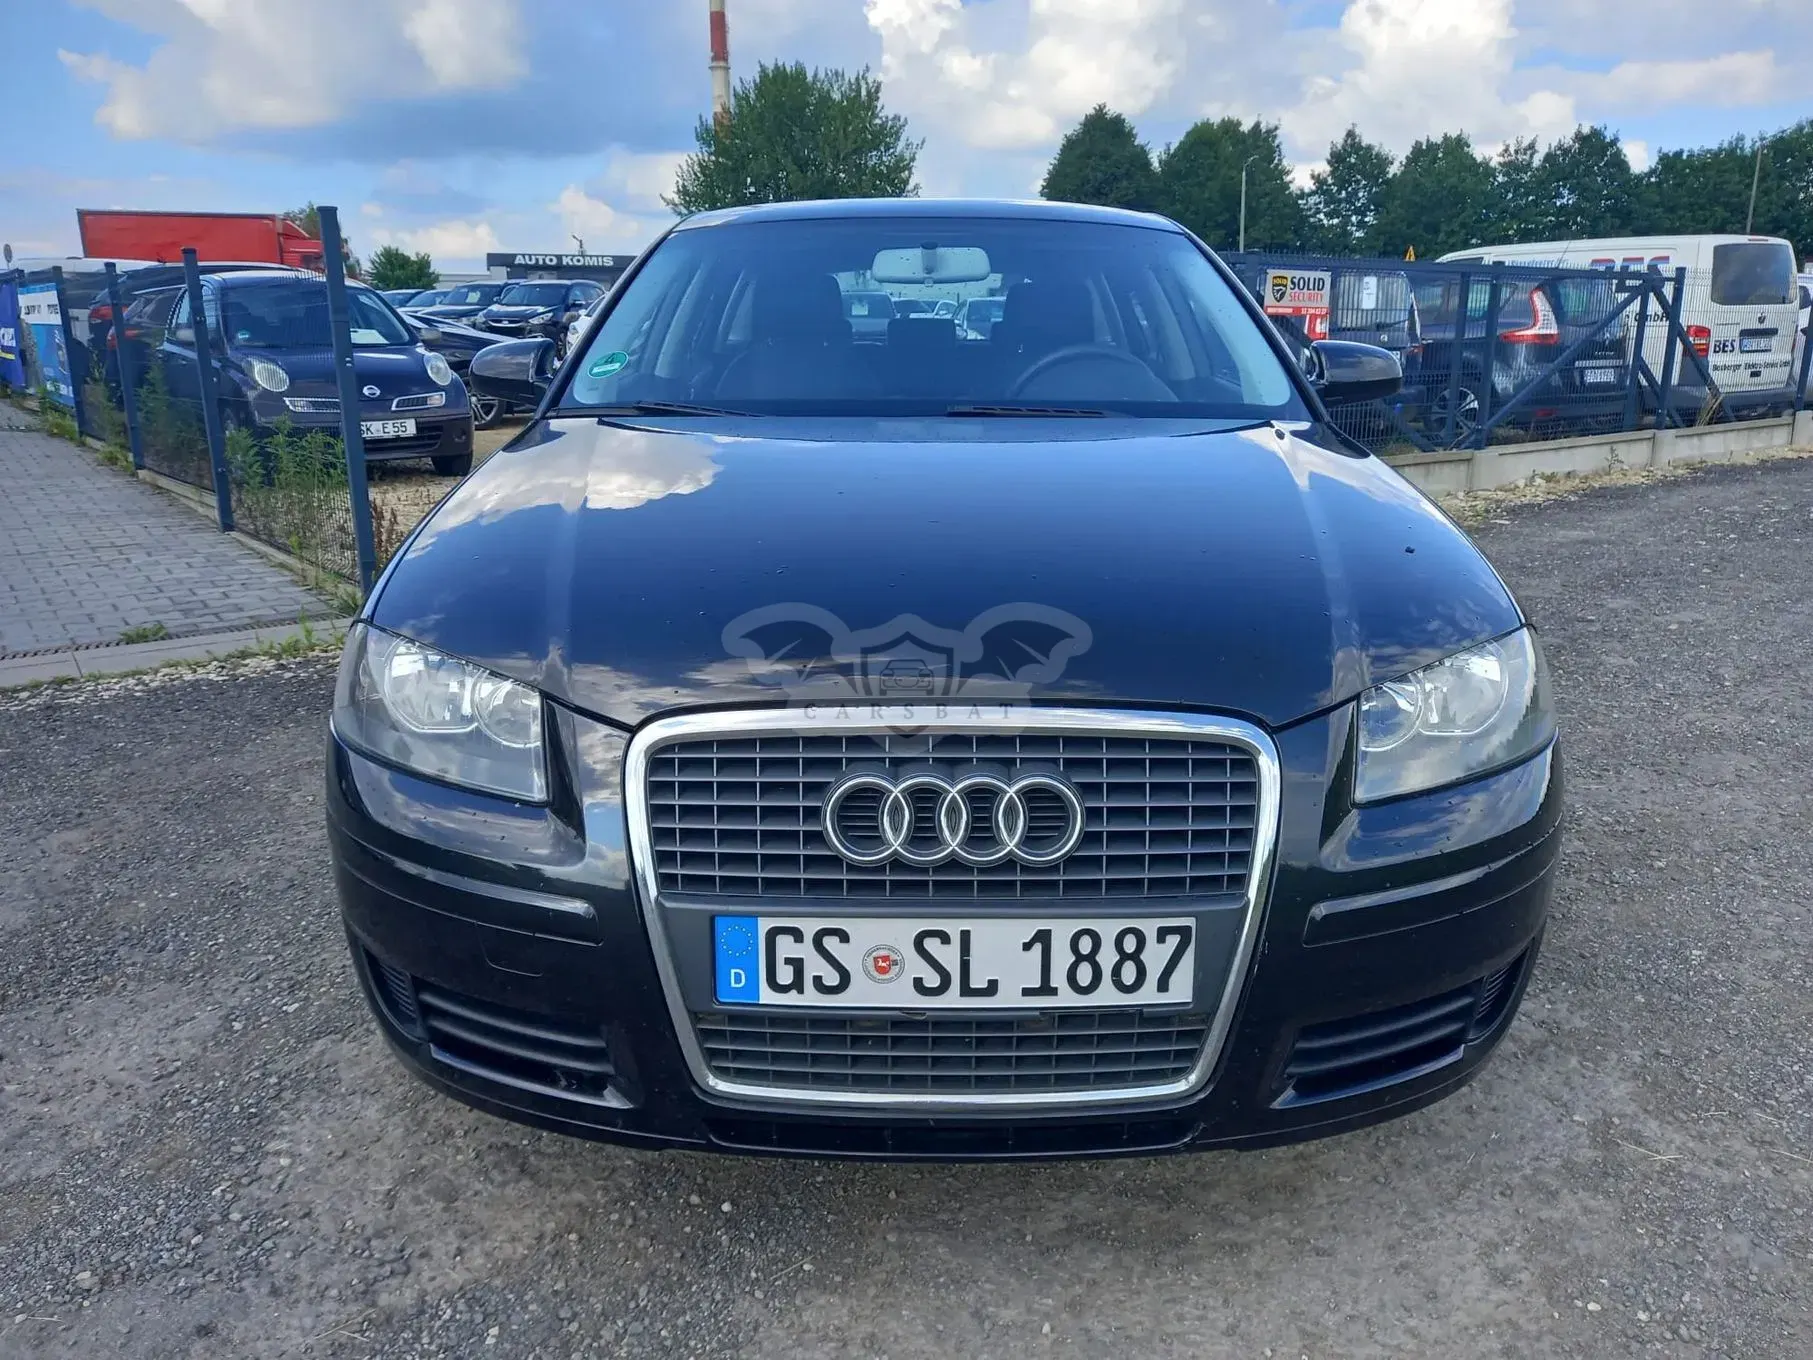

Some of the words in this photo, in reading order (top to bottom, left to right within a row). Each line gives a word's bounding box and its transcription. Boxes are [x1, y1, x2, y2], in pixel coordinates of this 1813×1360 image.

[514, 254, 557, 266] AUTO
[562, 256, 614, 267] KOMIS
[1290, 276, 1325, 292] SOLID
[1713, 339, 1735, 354] BES
[382, 422, 390, 434] E
[392, 421, 408, 433] 55
[764, 925, 852, 996] GS
[912, 928, 999, 998] SL
[1020, 925, 1194, 997] 1887
[730, 968, 746, 988] D
